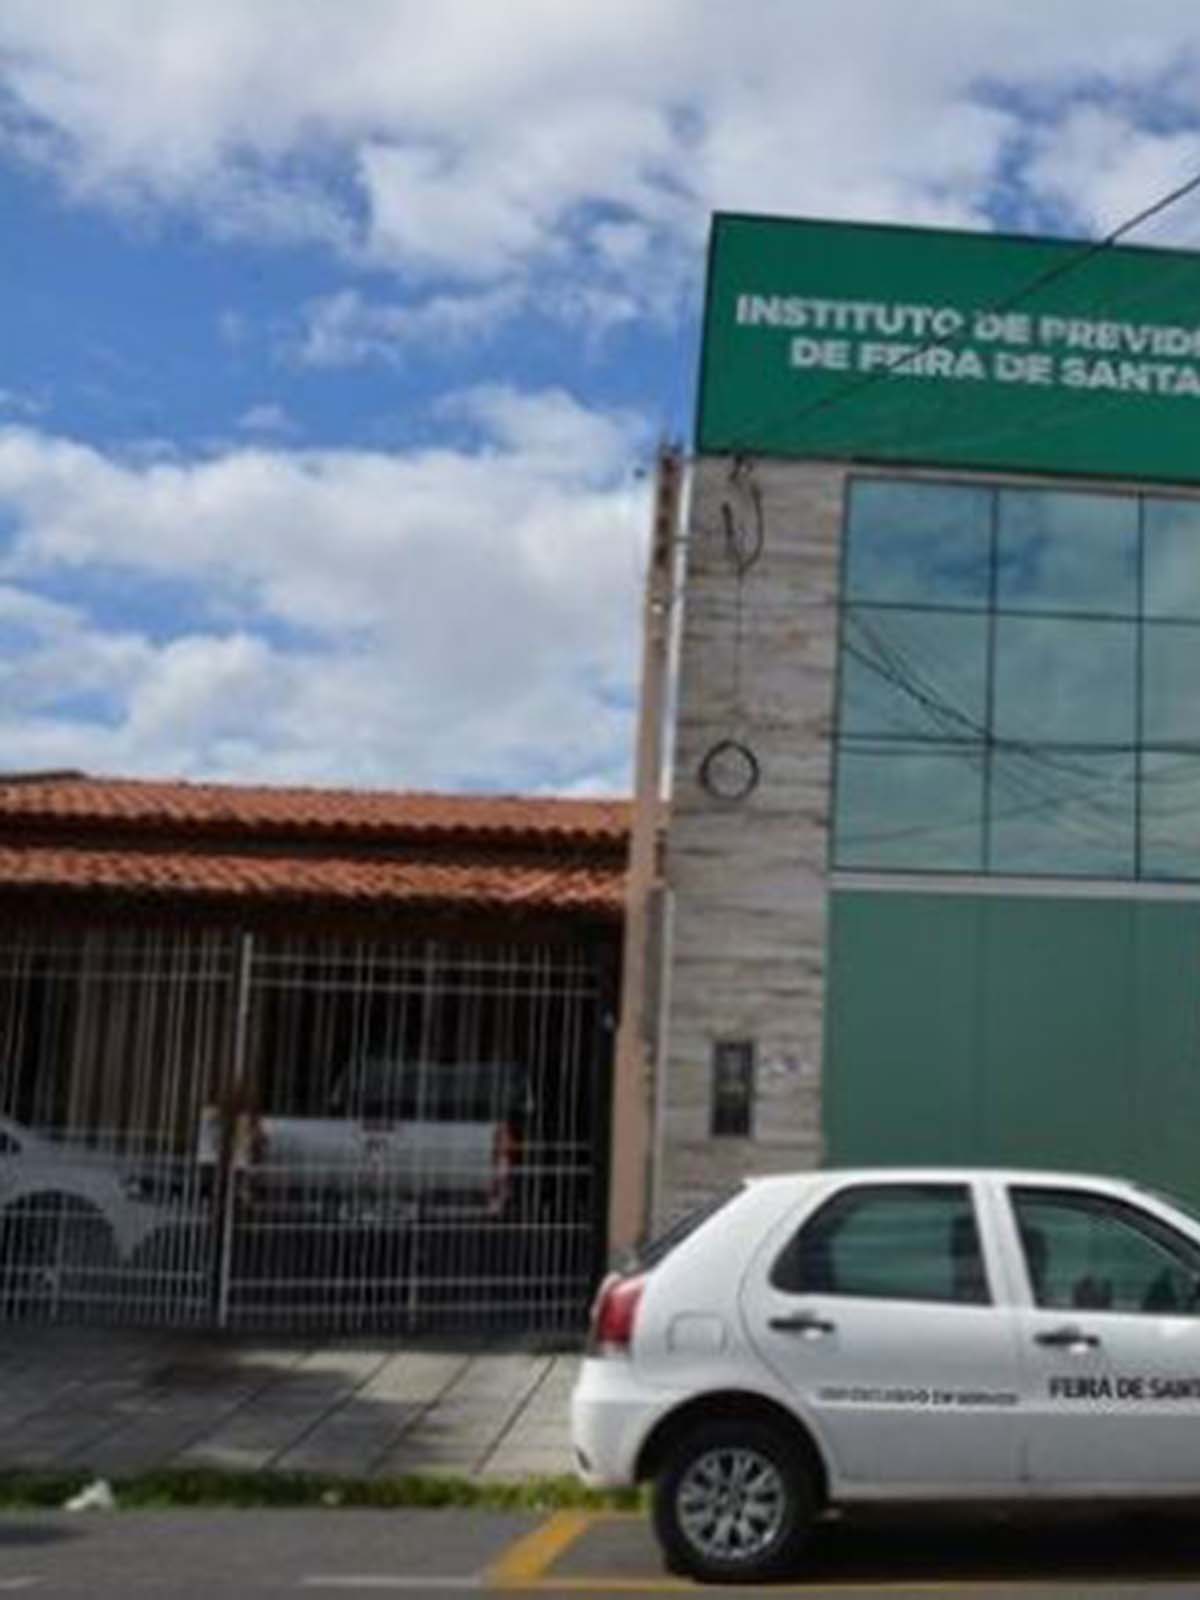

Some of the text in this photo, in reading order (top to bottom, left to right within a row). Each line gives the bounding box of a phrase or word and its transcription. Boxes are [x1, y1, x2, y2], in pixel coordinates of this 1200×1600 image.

[736, 294, 965, 337] INSTITUTO
[974, 312, 1031, 344] DE
[789, 336, 850, 371] DE
[857, 340, 987, 380] FEIRA
[994, 351, 1052, 386] DE
[1048, 1376, 1113, 1400] FEIRA
[1116, 1377, 1145, 1400] DE
